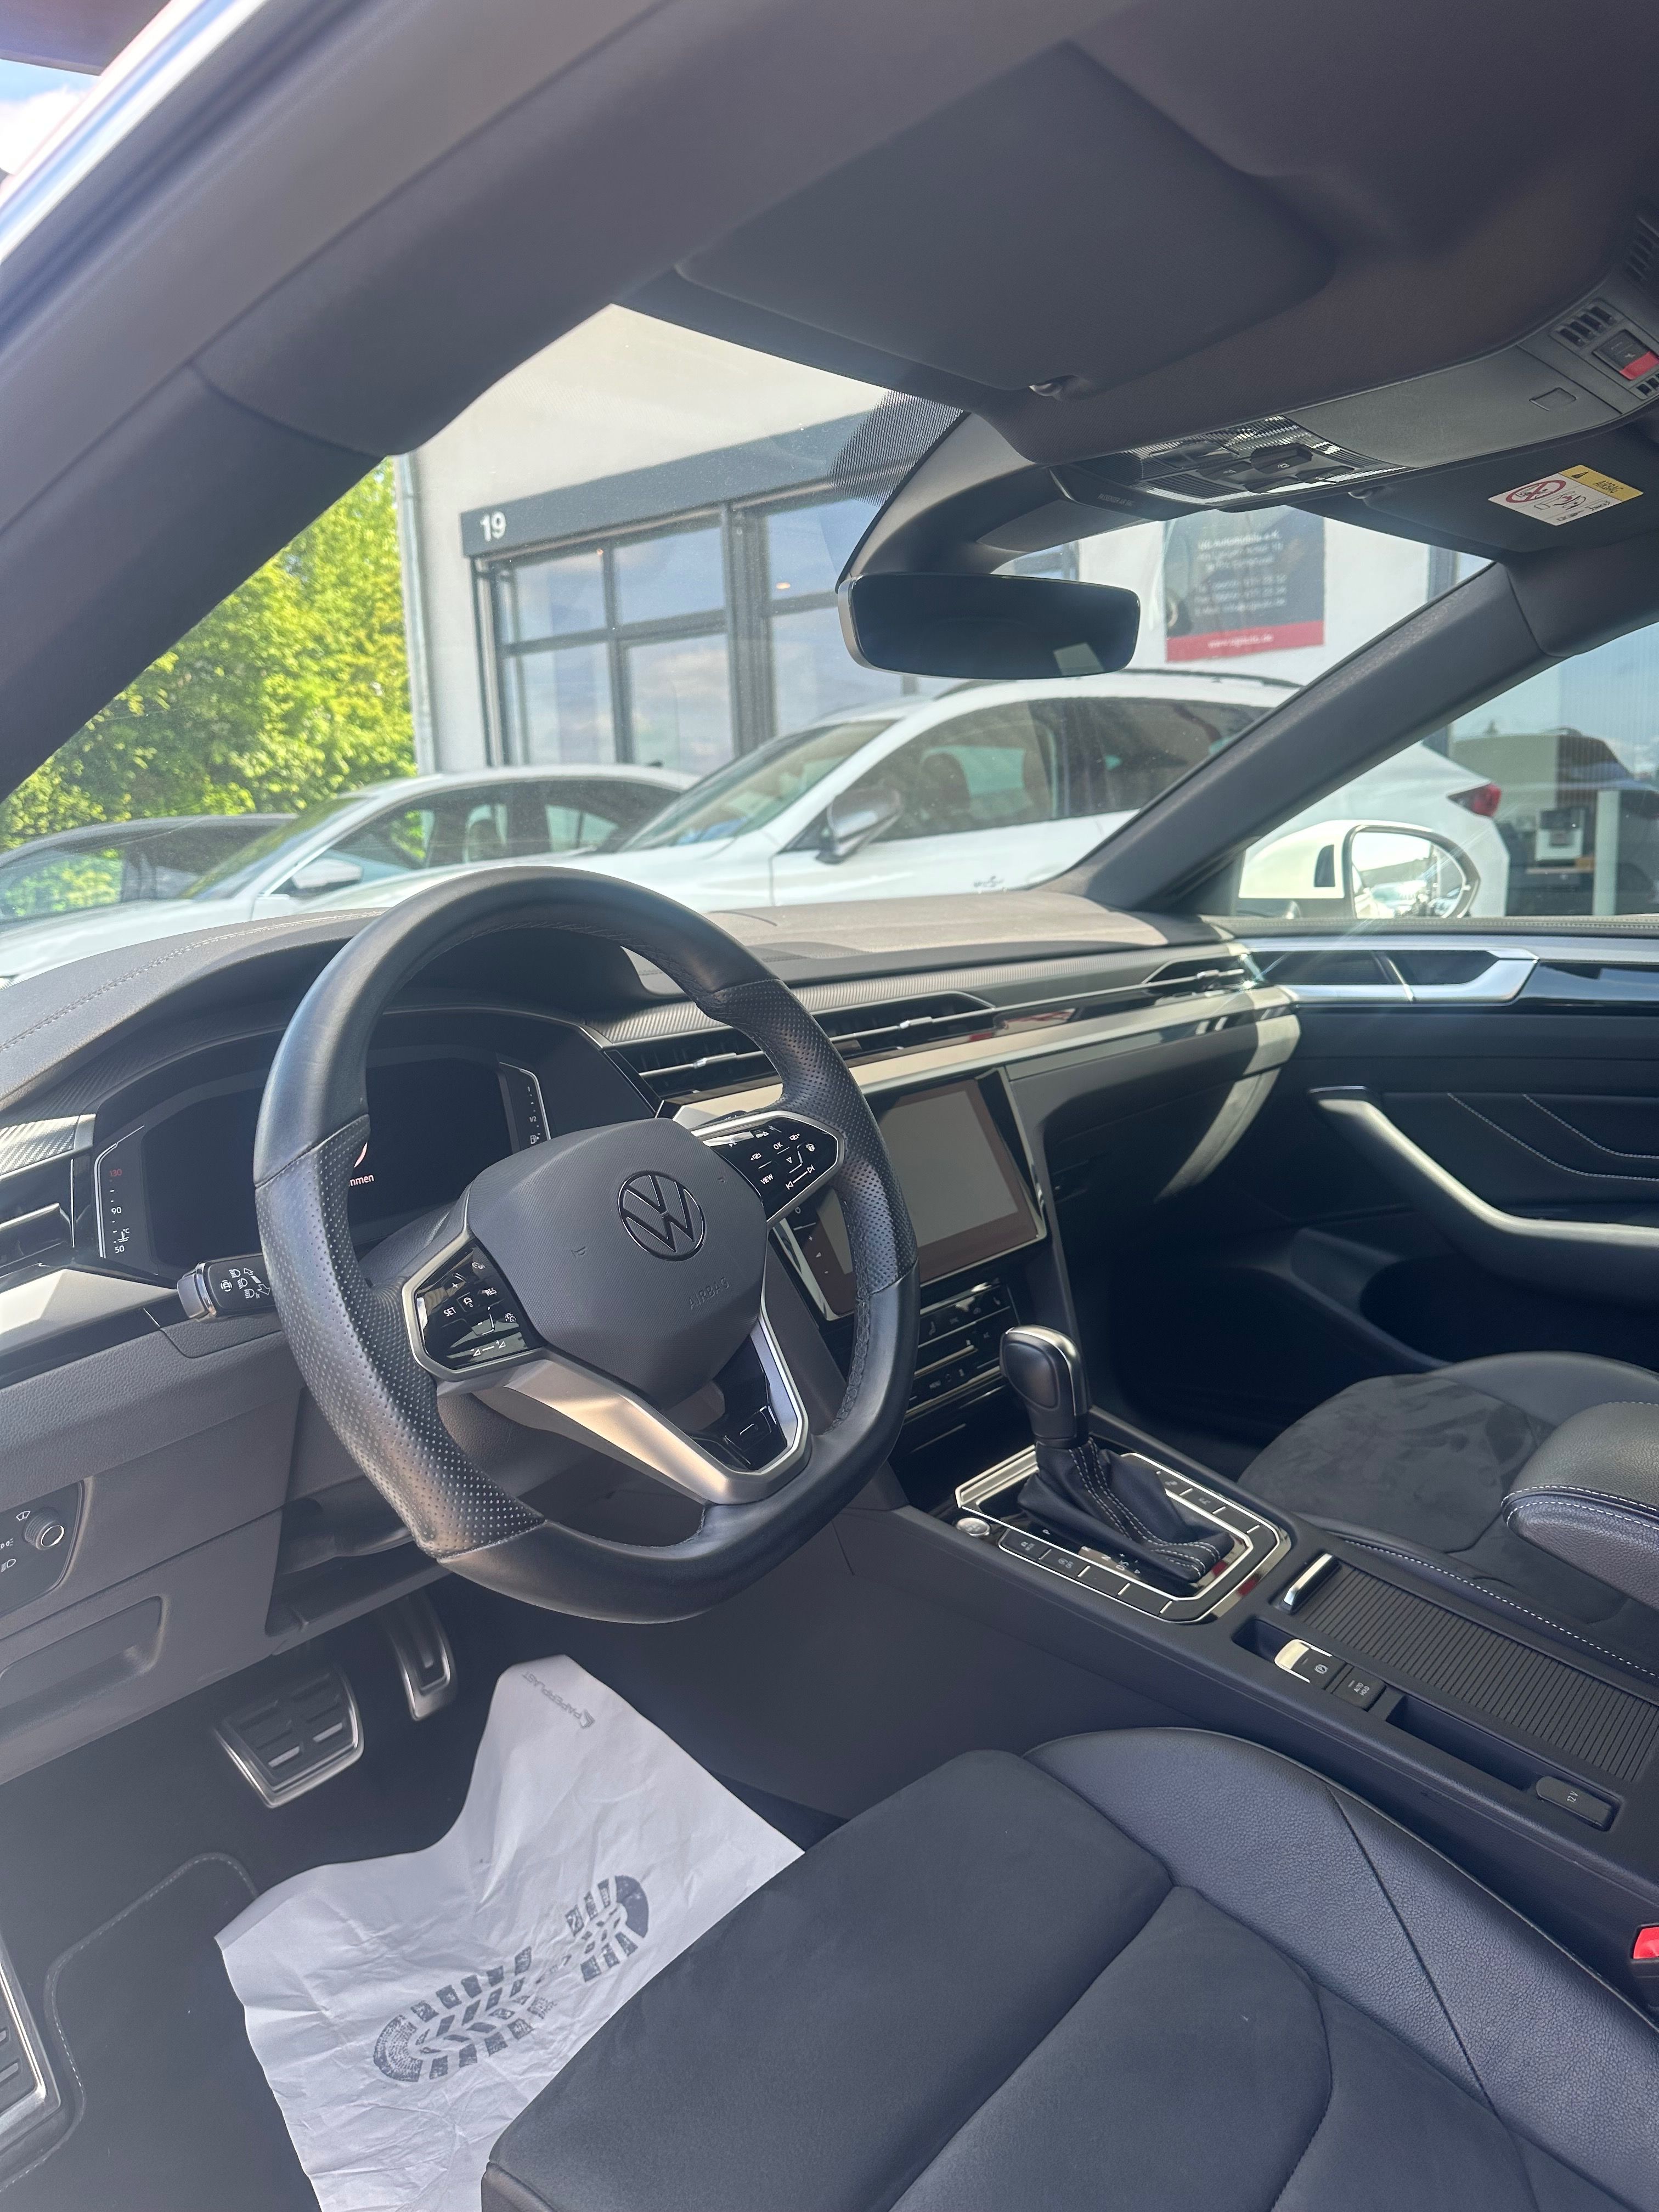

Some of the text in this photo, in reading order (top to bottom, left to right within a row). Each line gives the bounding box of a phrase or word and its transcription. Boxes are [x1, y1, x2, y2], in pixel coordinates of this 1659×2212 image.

[480, 511, 506, 541] 19
[773, 1141, 783, 1150] OK
[110, 1169, 122, 1177] 130
[760, 1173, 774, 1184] VIEW
[111, 1206, 122, 1215] 90
[115, 1245, 125, 1254] 50
[484, 1287, 497, 1296] RES
[689, 1277, 730, 1310] AIRBAG
[443, 1307, 456, 1317] SET
